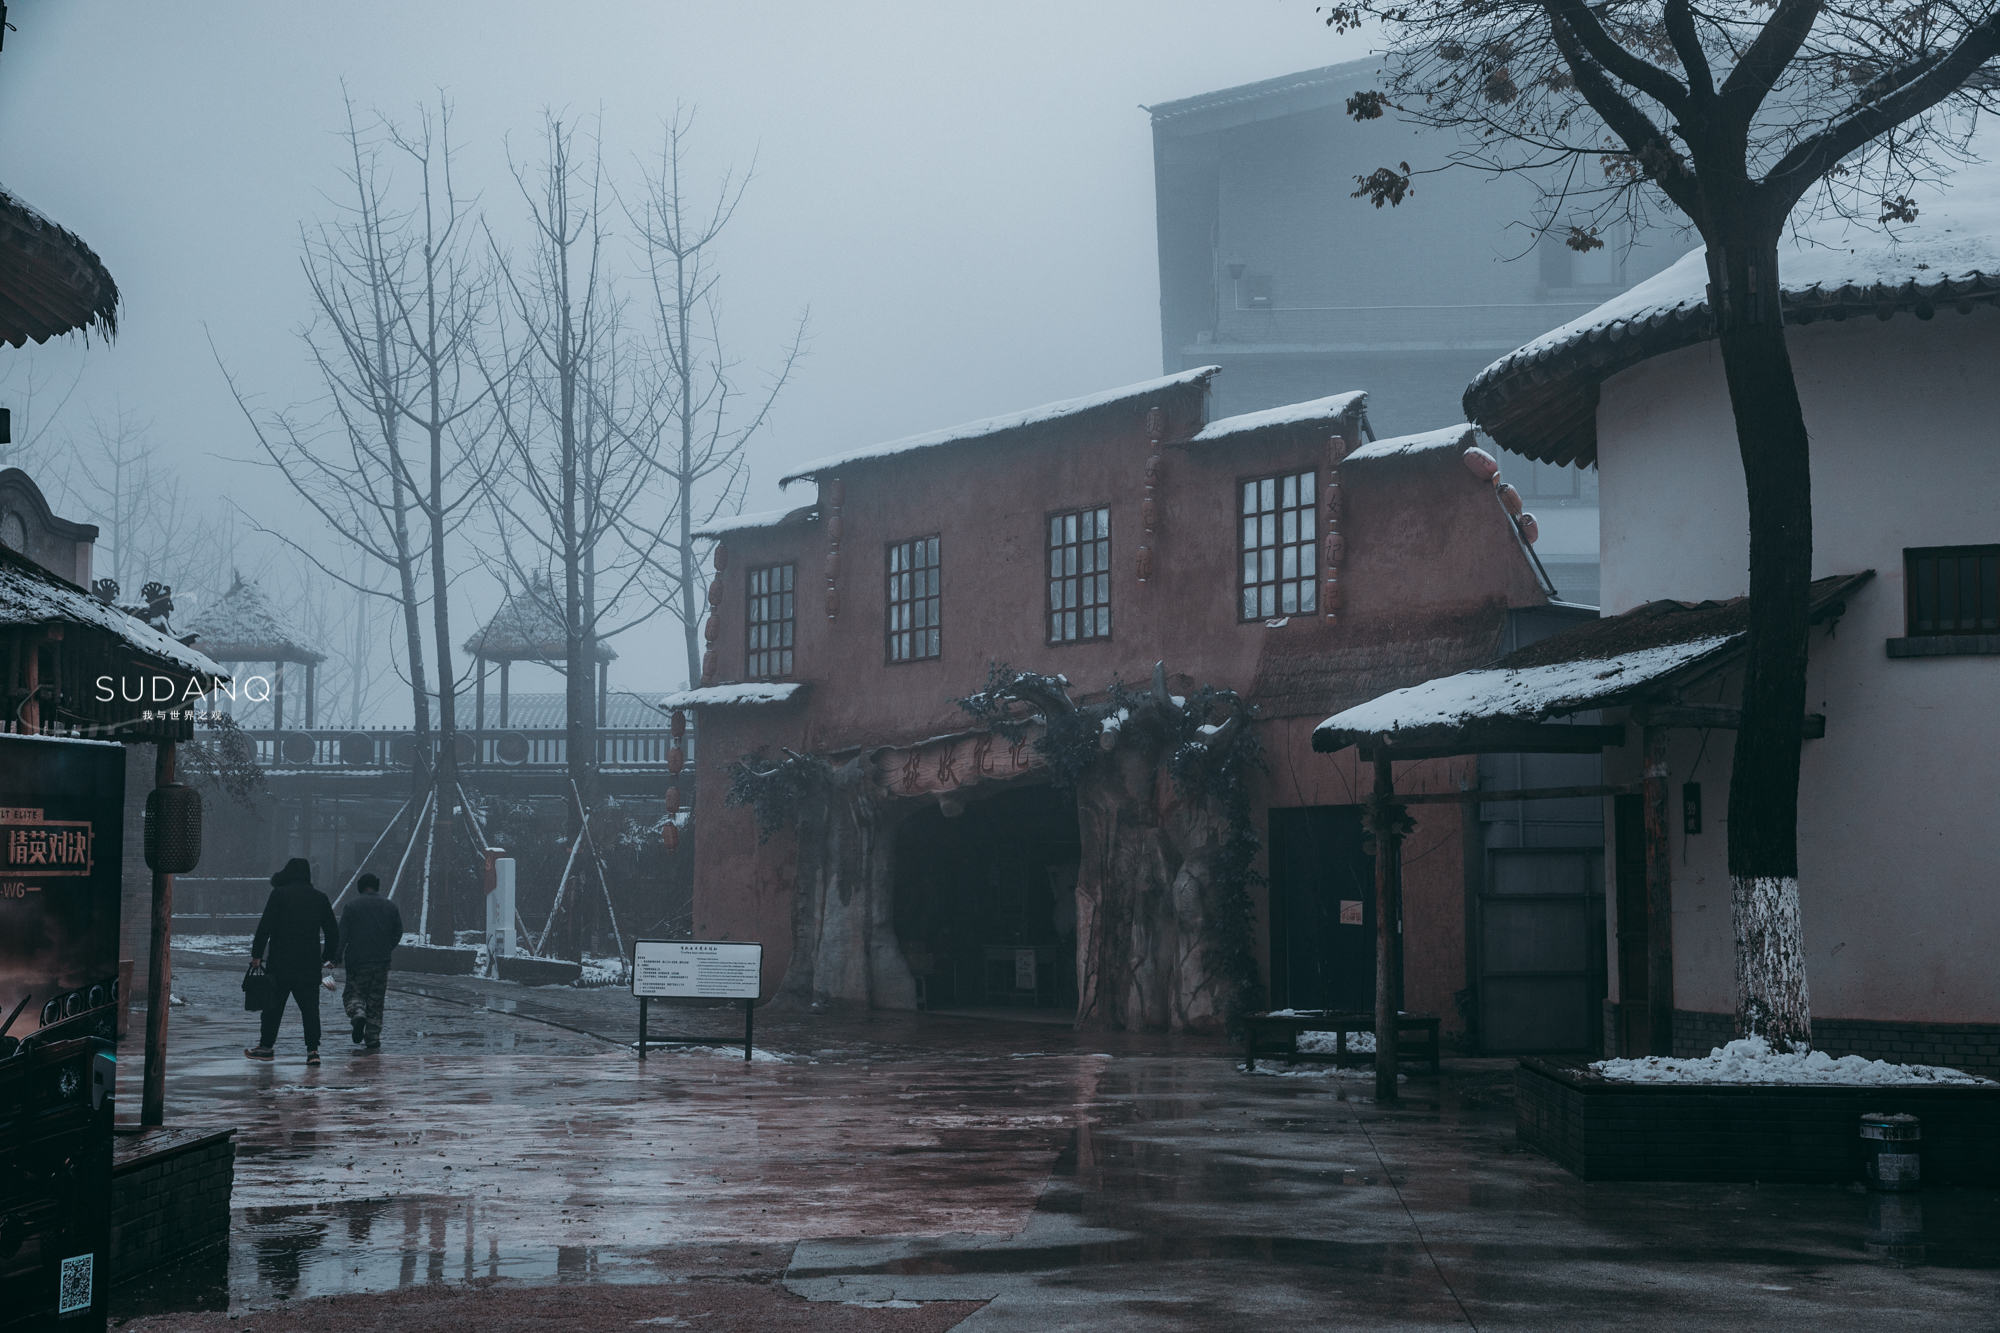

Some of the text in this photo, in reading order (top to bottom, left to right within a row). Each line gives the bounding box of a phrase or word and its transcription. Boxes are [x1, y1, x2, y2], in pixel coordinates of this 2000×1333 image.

[14, 811, 37, 819] ELITE
[8, 830, 87, 865] 精英对决
